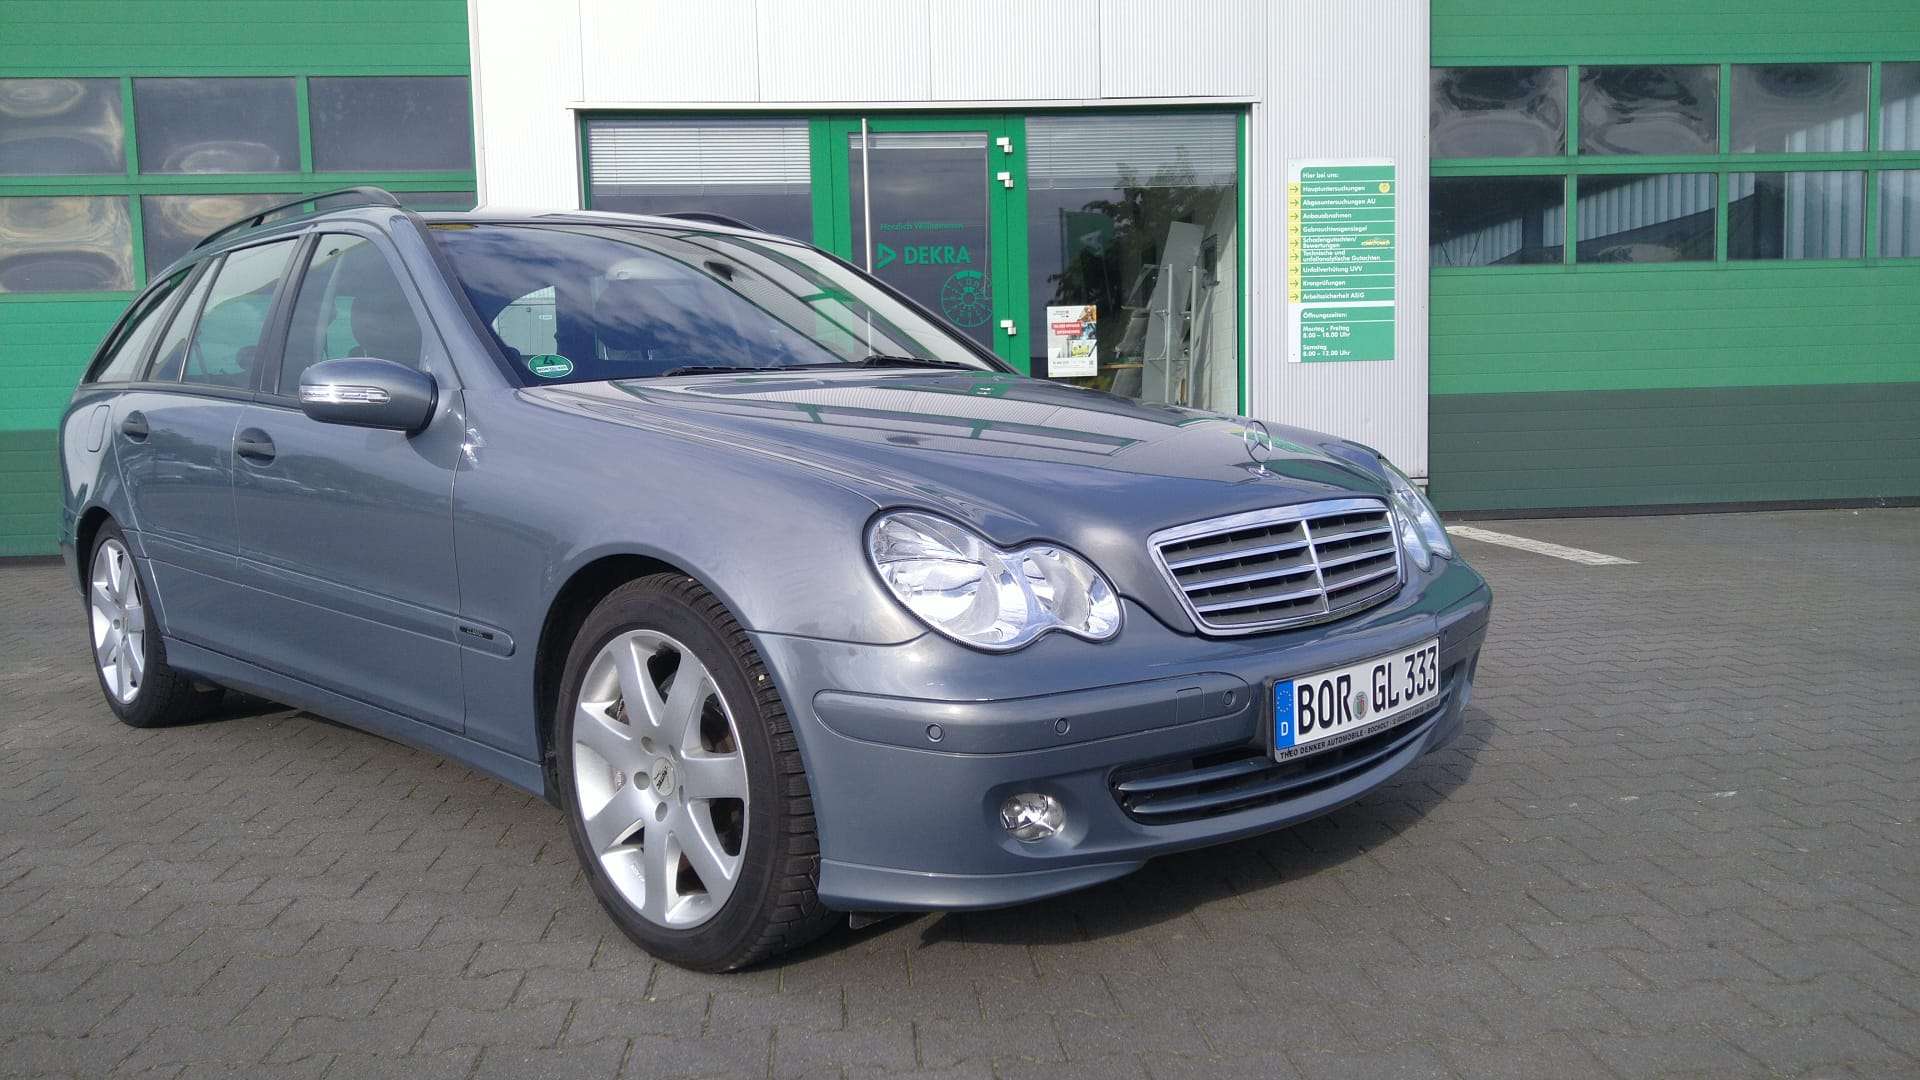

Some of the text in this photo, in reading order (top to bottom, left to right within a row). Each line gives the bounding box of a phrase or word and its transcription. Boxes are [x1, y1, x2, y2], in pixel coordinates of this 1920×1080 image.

[1303, 185, 1365, 193] Hauptuntersuchungen
[904, 246, 972, 265] DEKRA
[1297, 674, 1352, 736] BOR
[1372, 662, 1400, 713] GL
[1404, 645, 1438, 701] 333
[1281, 721, 1289, 737] D
[1280, 748, 1299, 760] THEO
[1300, 740, 1326, 754] DENKER
[1327, 728, 1364, 747] AUTOMOBILE
